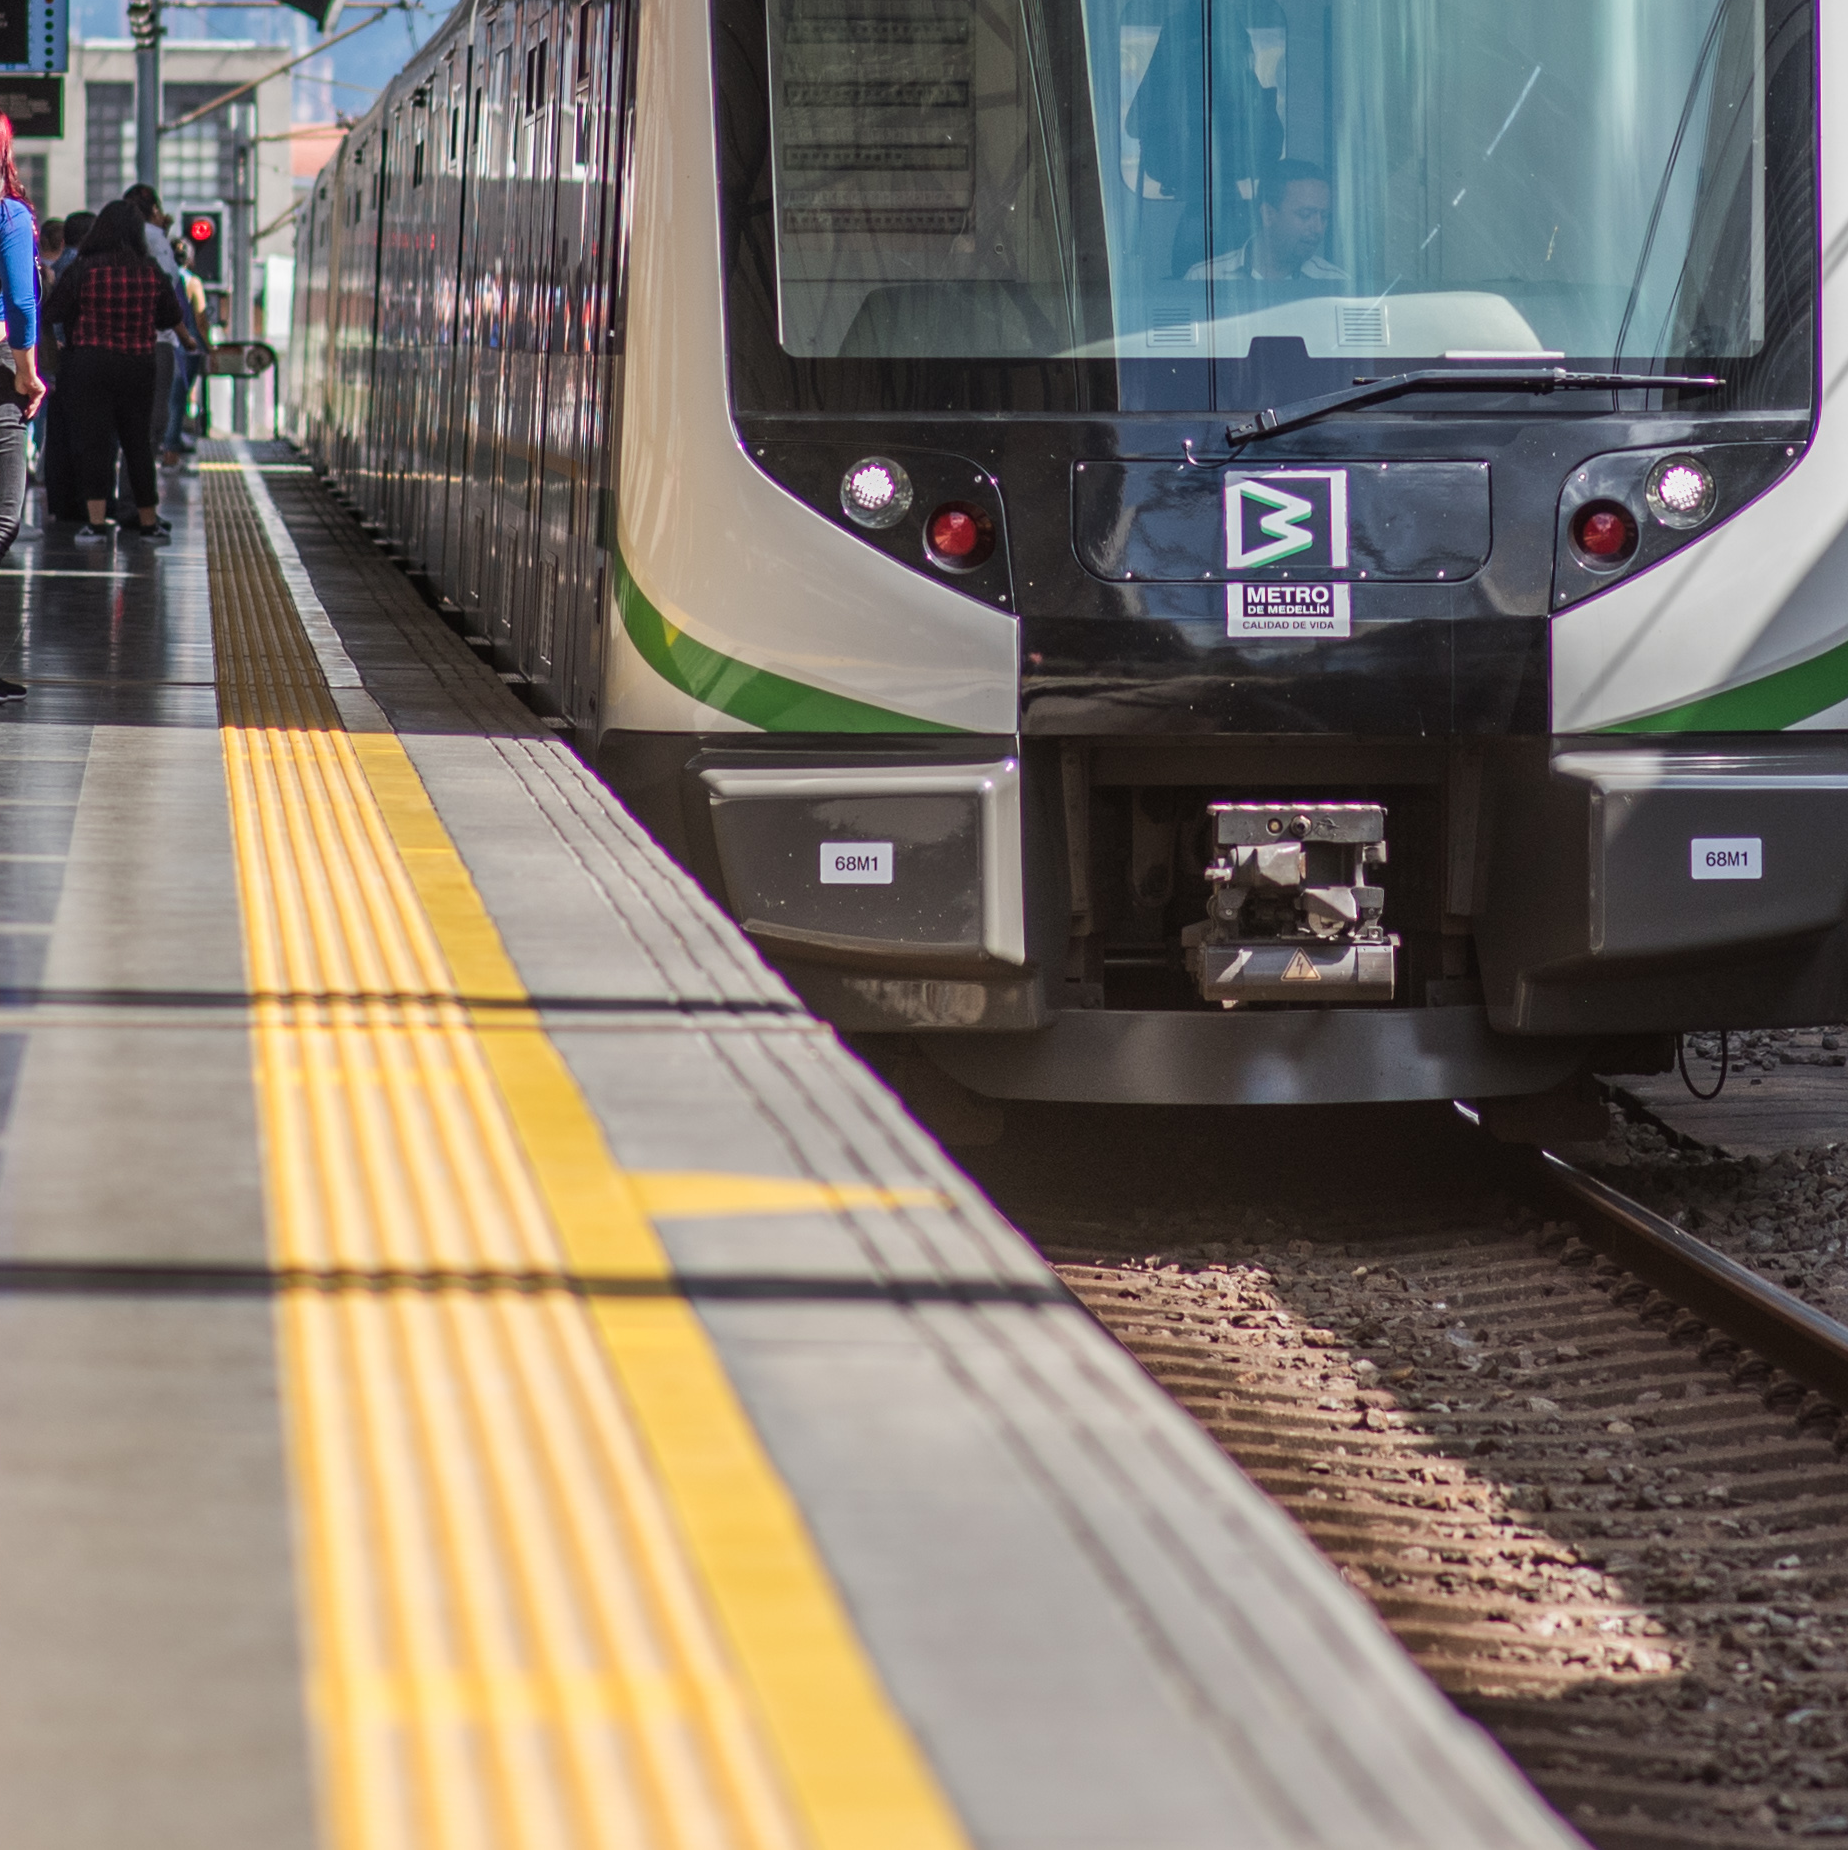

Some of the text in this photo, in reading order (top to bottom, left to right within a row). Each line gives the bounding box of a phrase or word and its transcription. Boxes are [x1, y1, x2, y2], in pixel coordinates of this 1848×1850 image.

[1246, 586, 1329, 604] METRO
[1248, 603, 1330, 615] DE MEDELLÍN
[1242, 620, 1334, 630] CALIDAD DE VIDA
[835, 855, 878, 871] 68M1
[1705, 851, 1748, 867] 68M1
